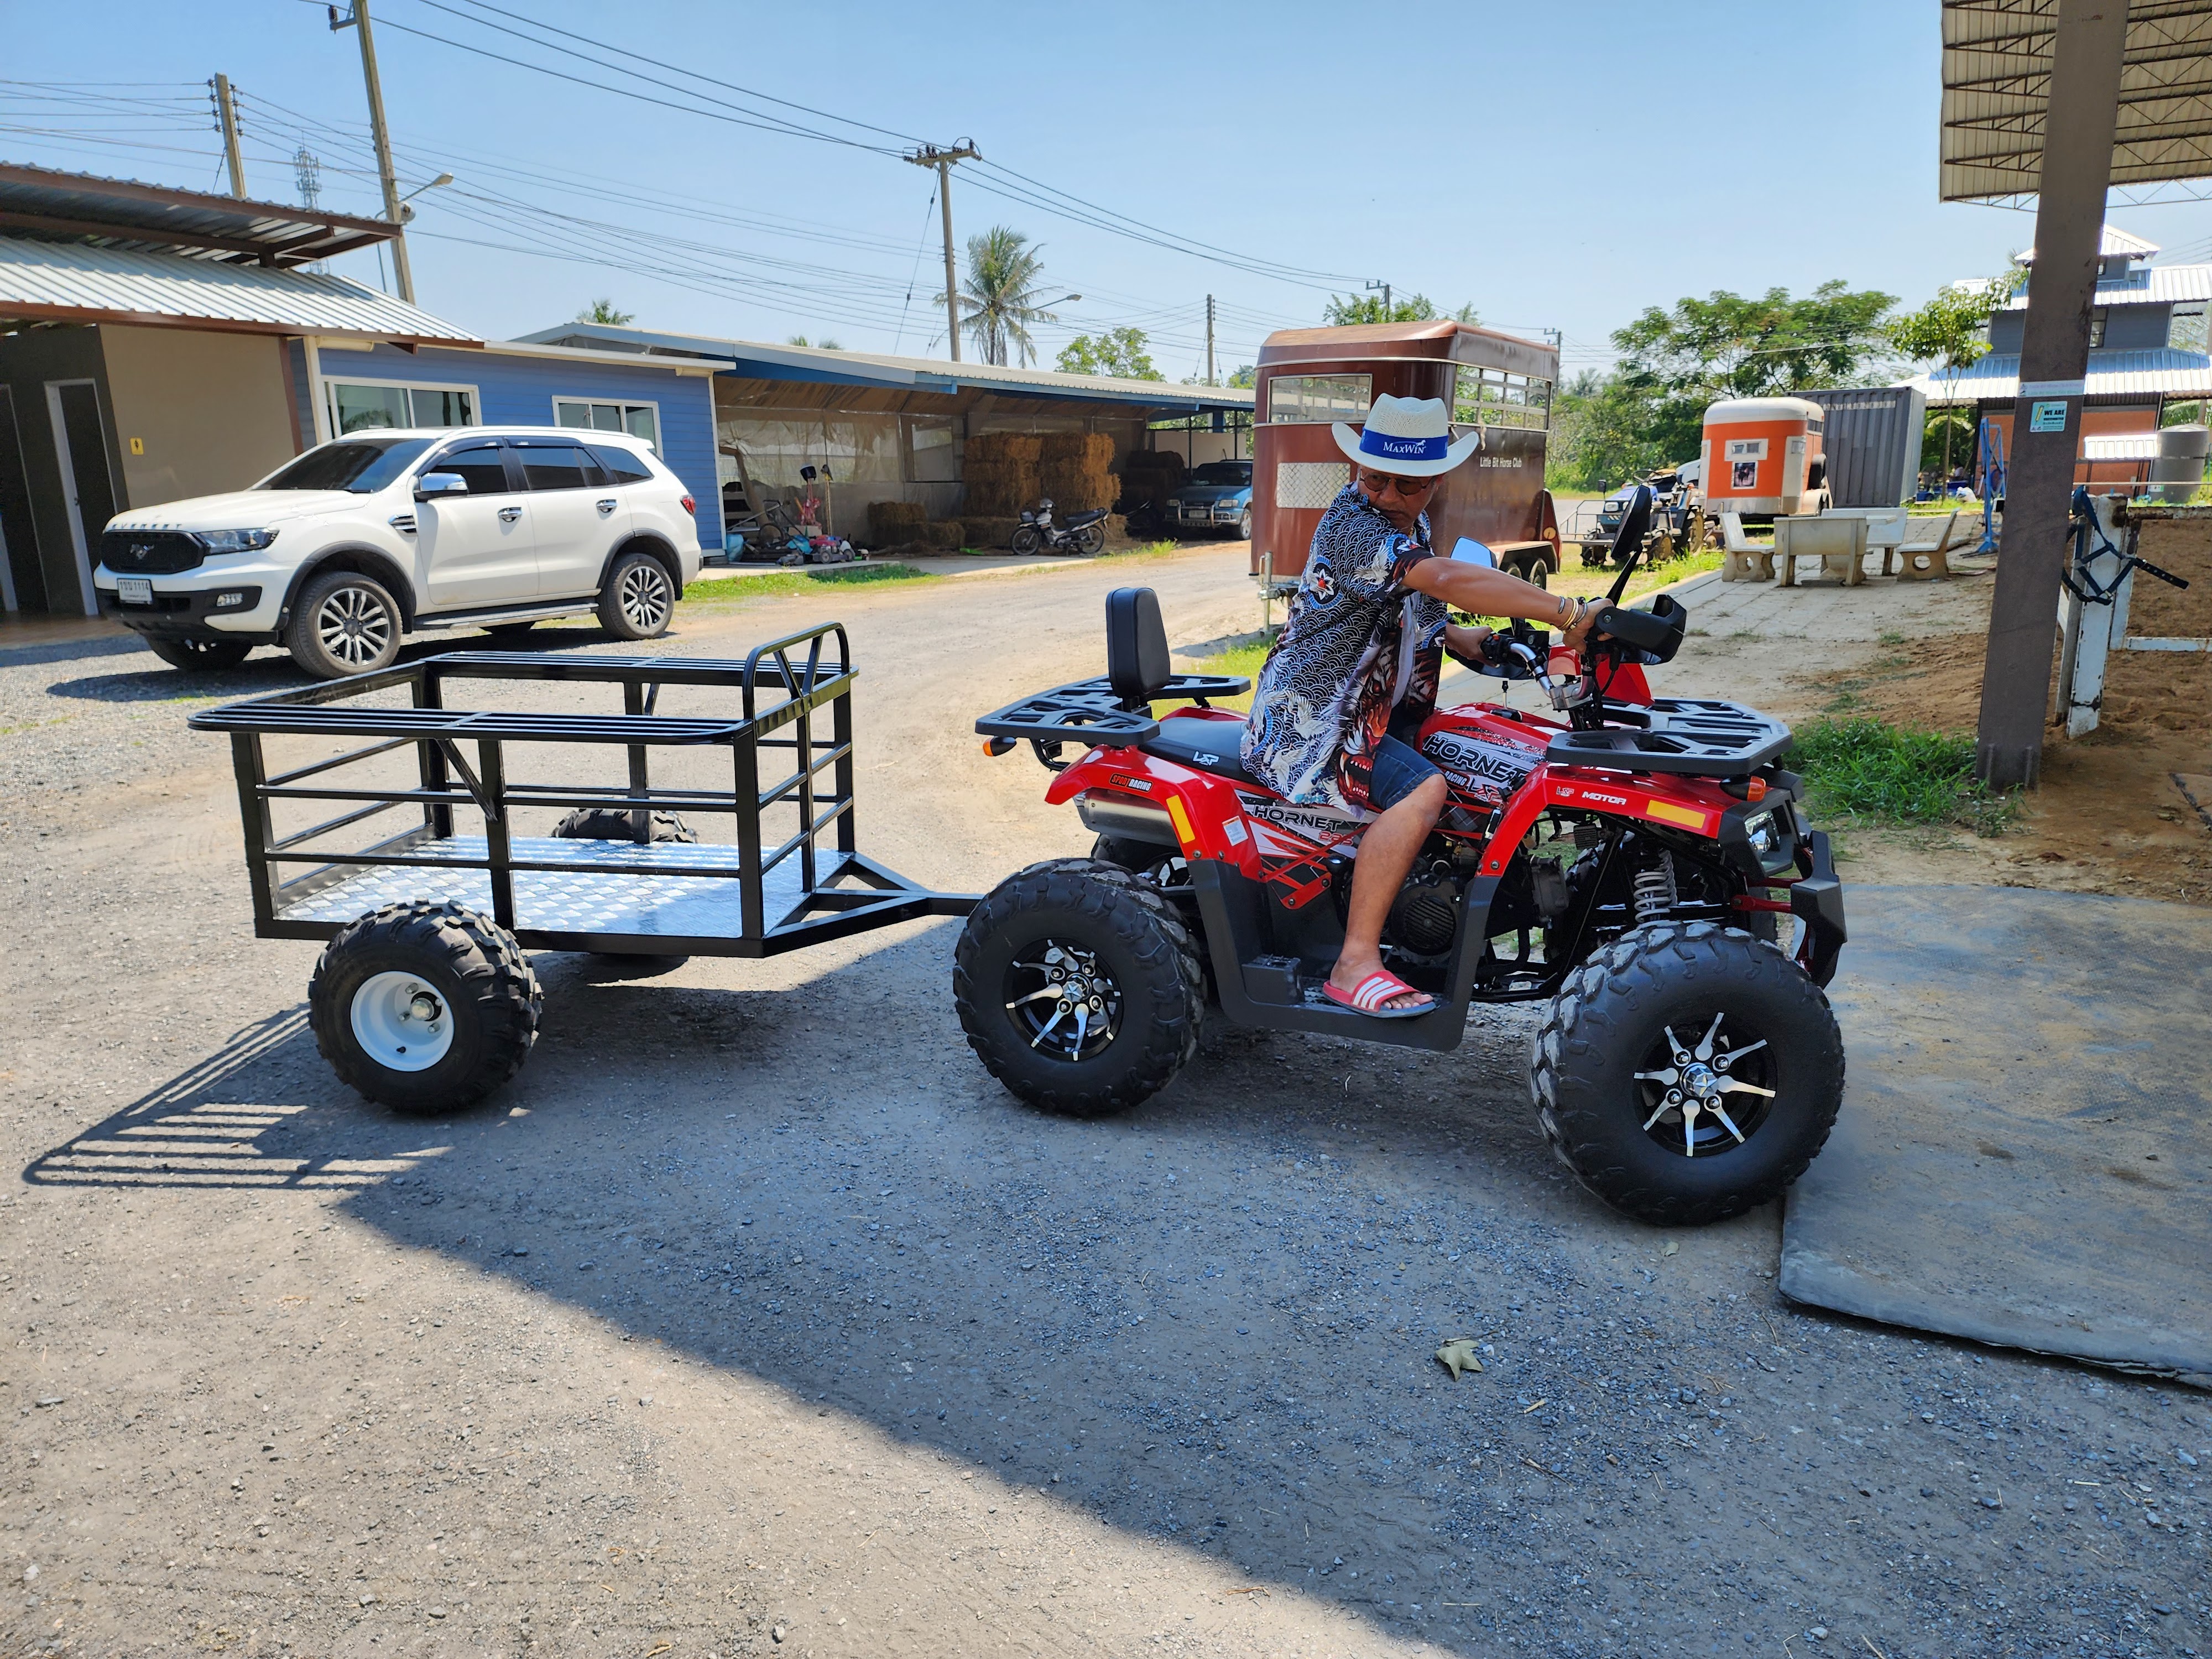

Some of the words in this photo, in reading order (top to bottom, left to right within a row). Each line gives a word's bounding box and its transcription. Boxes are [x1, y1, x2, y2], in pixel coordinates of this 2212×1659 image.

[1480, 457, 1491, 467] Little
[1500, 457, 1512, 467] Horse
[1512, 457, 1522, 467] Club
[1422, 734, 1531, 782] HORNET
[1112, 775, 1130, 786] SPORT
[1128, 779, 1152, 791] RACING
[1444, 770, 1468, 786] RACING
[1582, 791, 1627, 805] MOTOR
[1253, 804, 1344, 831] HORNET
